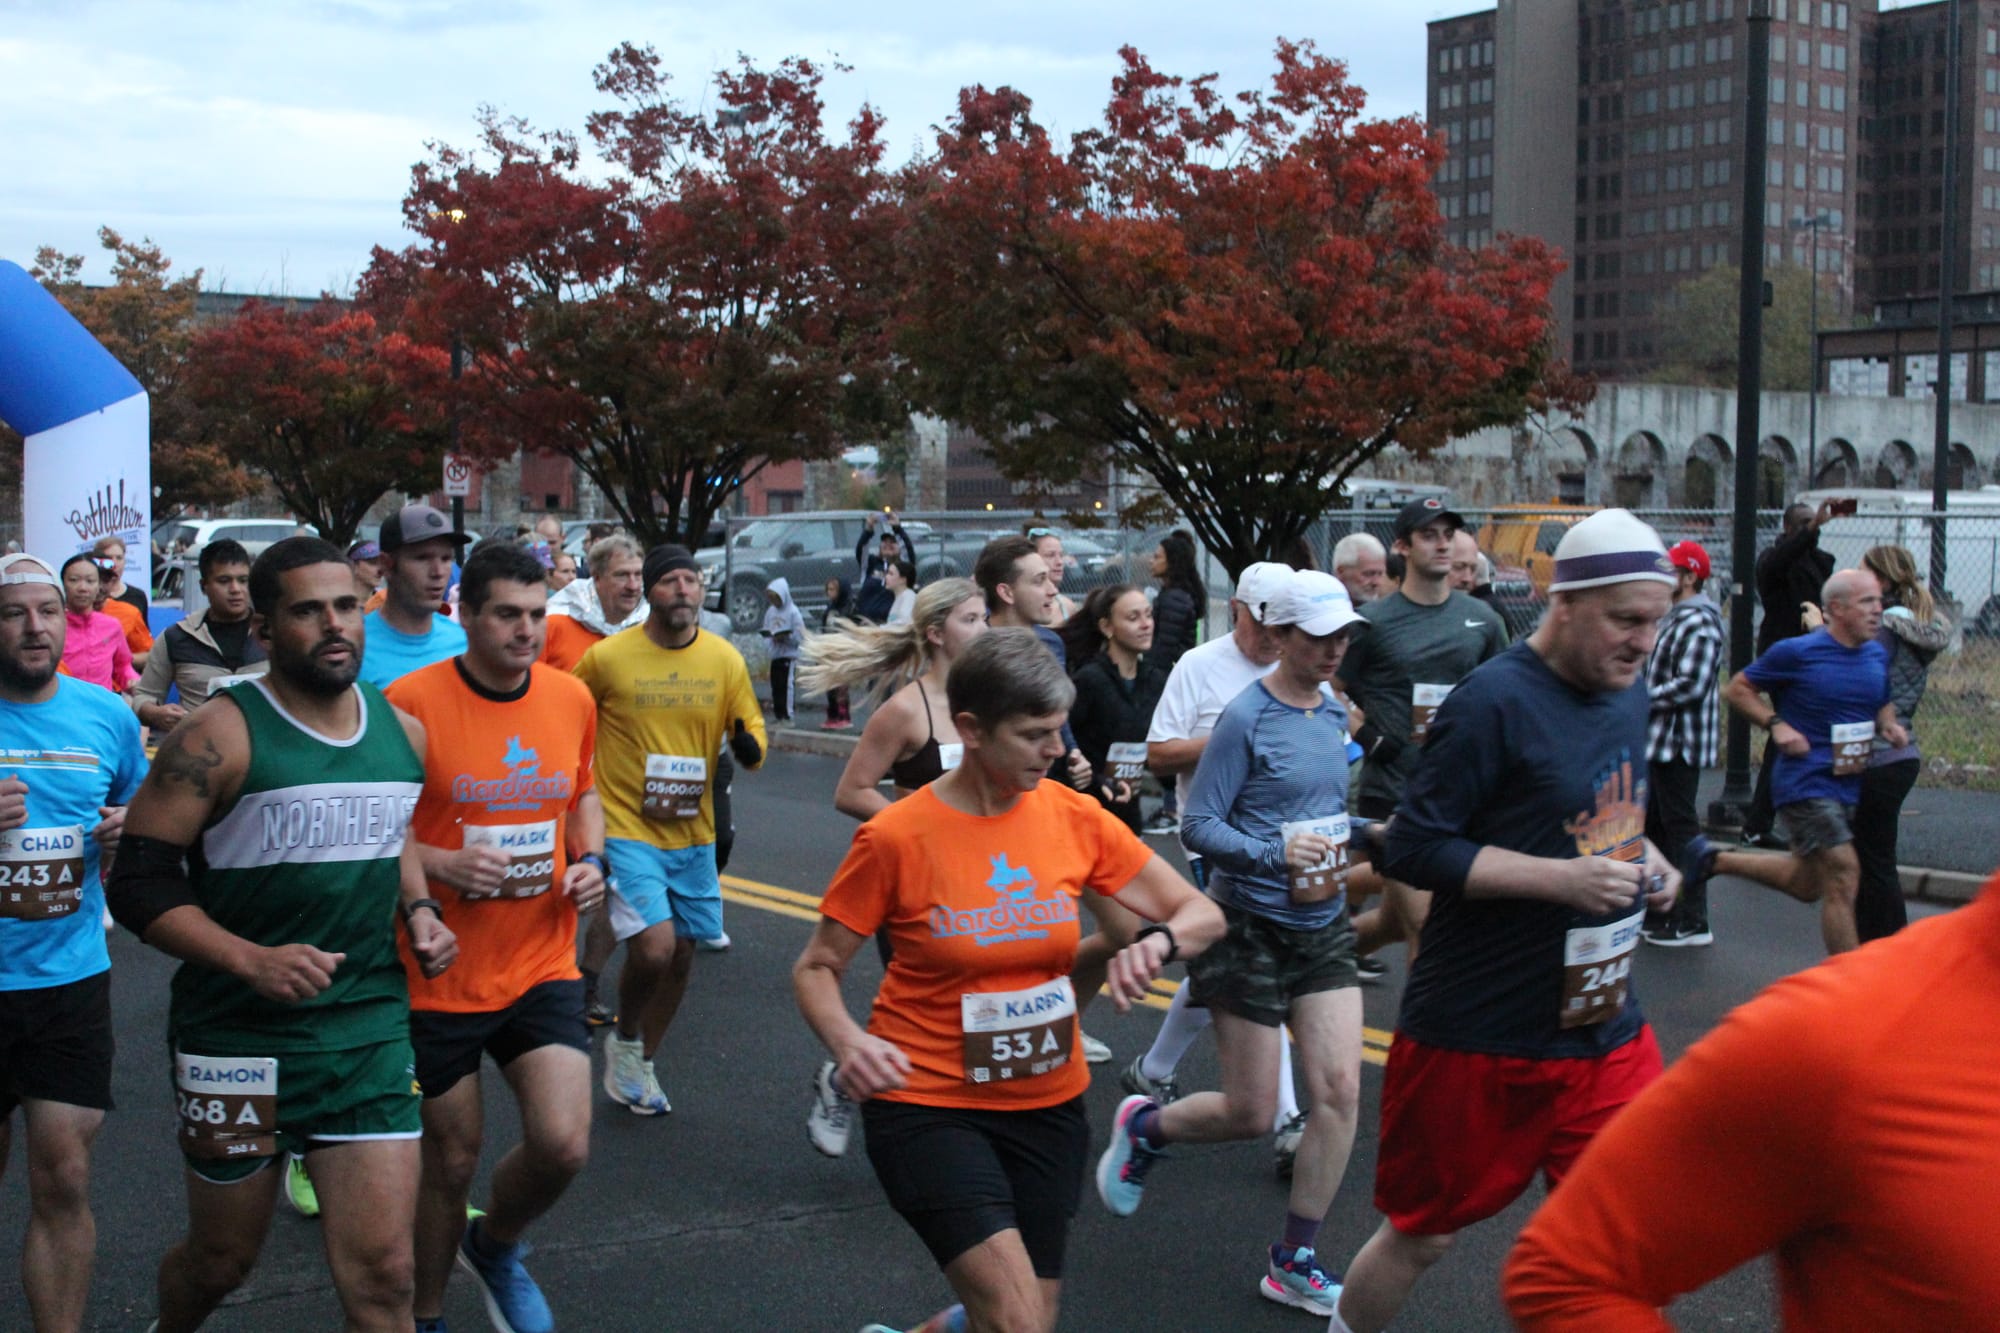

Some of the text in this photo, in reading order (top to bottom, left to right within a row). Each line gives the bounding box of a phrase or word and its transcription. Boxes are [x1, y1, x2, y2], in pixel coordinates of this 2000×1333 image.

[63, 478, 146, 541] Bethlehem
[670, 762, 702, 774] KEVIN
[22, 835, 74, 852] CHAD
[500, 829, 550, 848] MARK
[0, 863, 73, 887] 243 A
[48, 904, 63, 913] 243
[929, 891, 1078, 938] Aardvark
[1006, 988, 1066, 1018] KAREN
[991, 1027, 1059, 1061] 53 A
[190, 1066, 265, 1083] RAMON
[178, 1092, 261, 1125] 268 A
